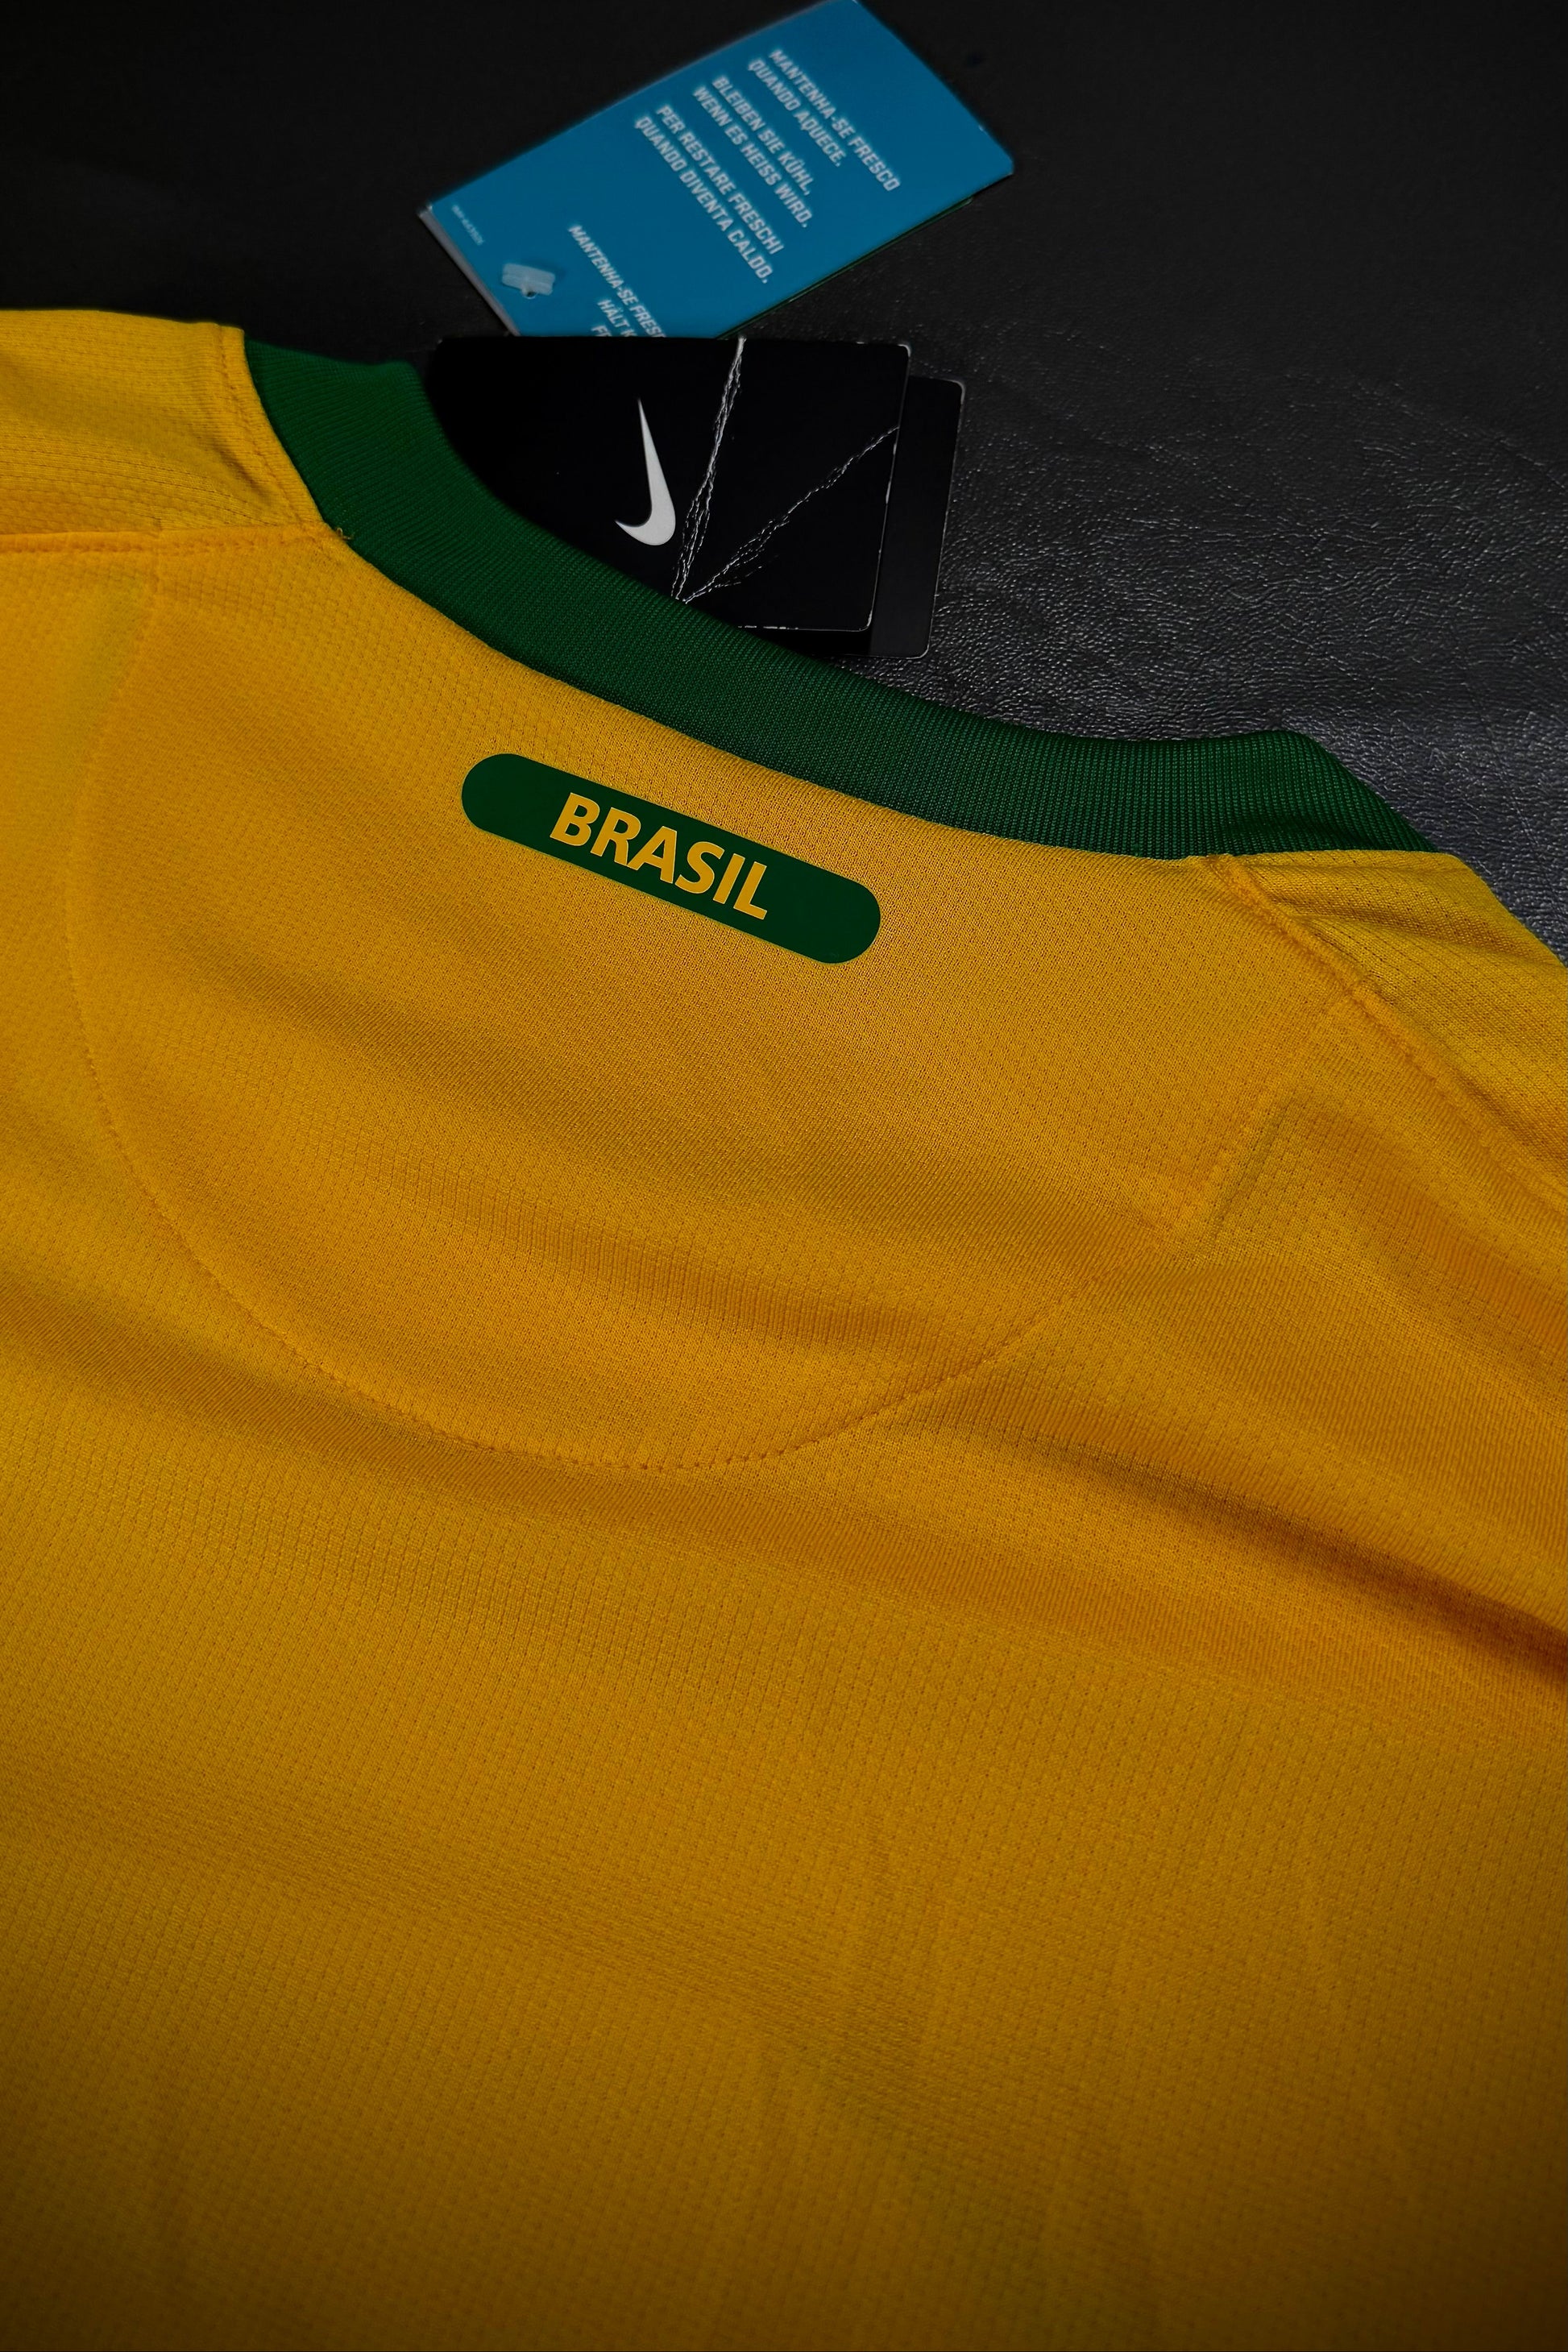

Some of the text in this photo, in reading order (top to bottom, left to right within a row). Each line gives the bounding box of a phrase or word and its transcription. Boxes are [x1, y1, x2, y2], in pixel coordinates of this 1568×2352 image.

[656, 105, 785, 255] PER RESTARE FRESCHI
[693, 87, 812, 228] WENN ES HEISS WIRD.
[712, 76, 813, 196] BLEIBEN SIE KÜHL,
[748, 59, 846, 167] QUANDO AQUECE.
[769, 49, 901, 191] MANTENHA-SE FRESCO
[568, 225, 639, 305] MANTENHA-SE
[634, 116, 773, 284] QUANDO DIVENTA CALDO.
[550, 792, 767, 920] BRASIL
